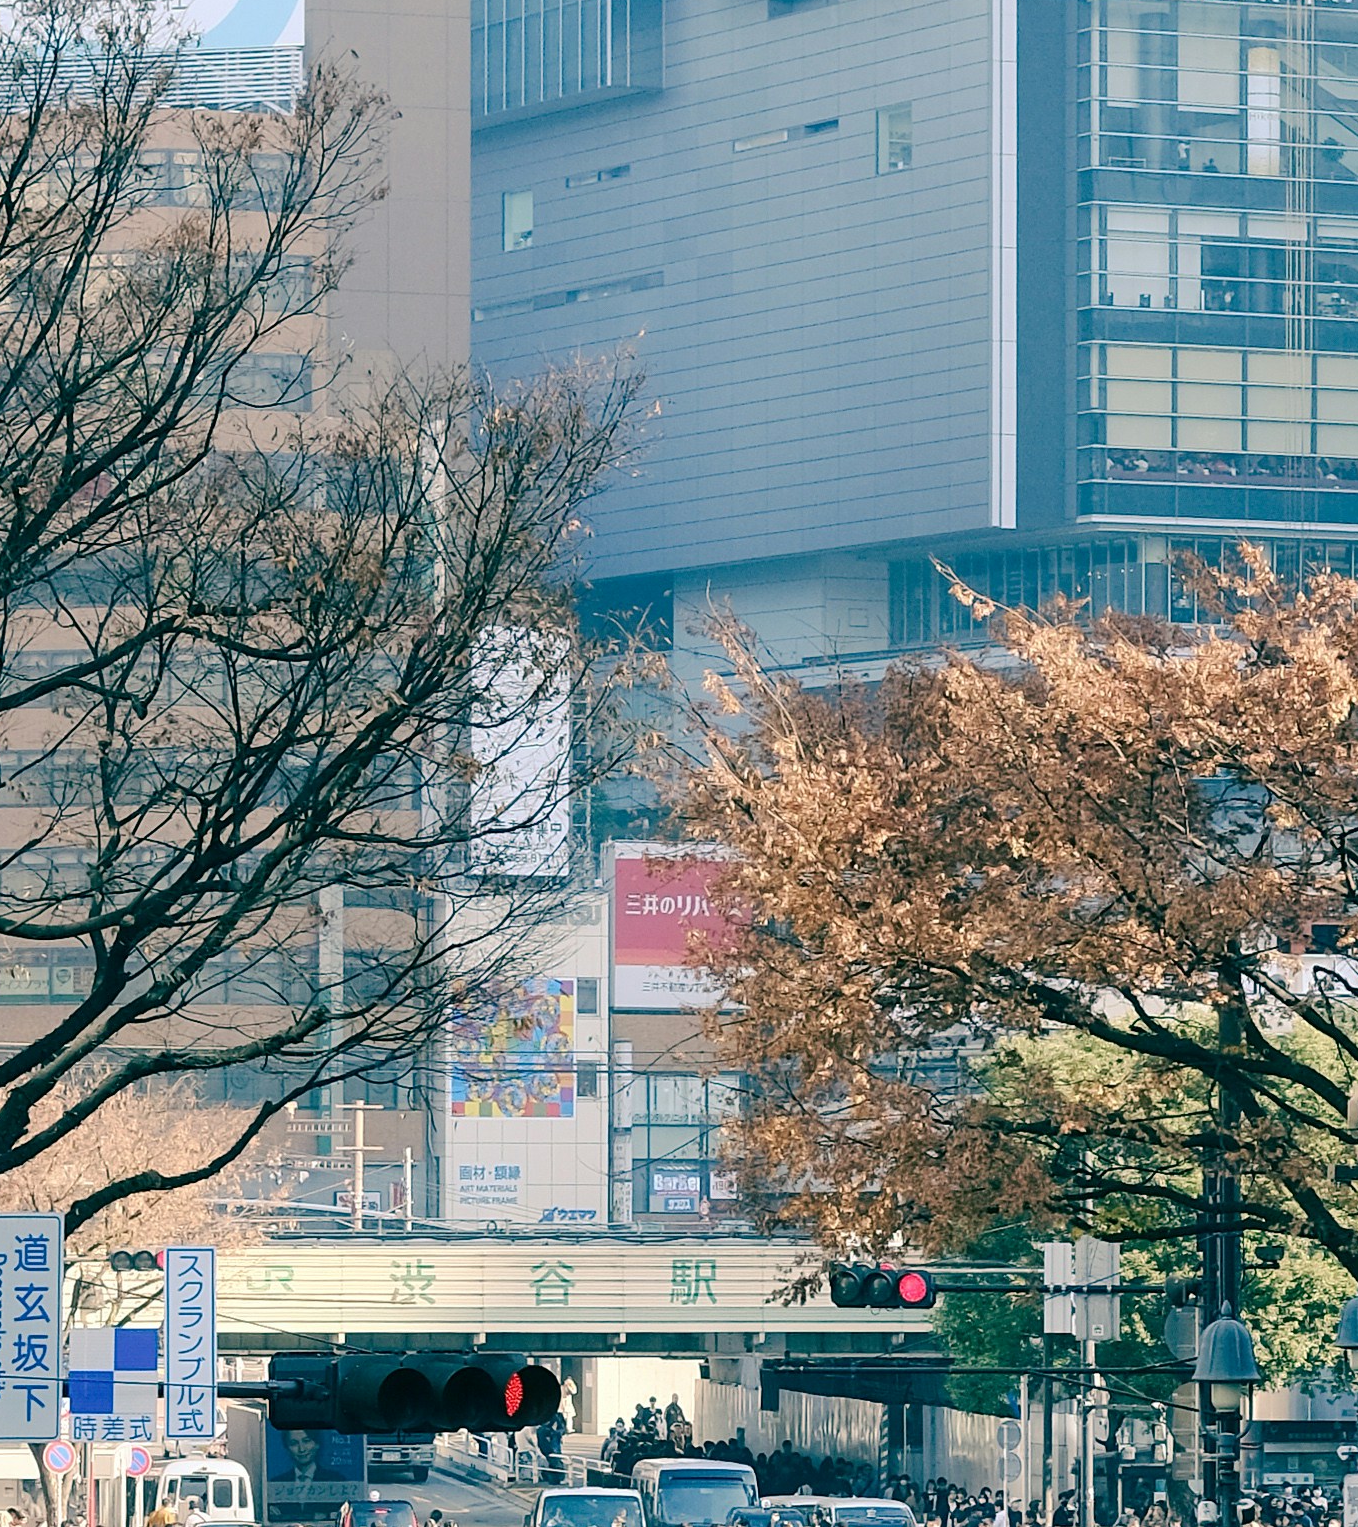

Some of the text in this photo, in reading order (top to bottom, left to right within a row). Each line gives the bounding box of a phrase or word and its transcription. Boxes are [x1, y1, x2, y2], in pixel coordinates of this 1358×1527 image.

[11, 1232, 51, 1423] 道玄坂下
[390, 1258, 719, 1307] 渋谷駅
[177, 1254, 206, 1433] スクランブル式
[73, 1415, 152, 1442] 時差式
